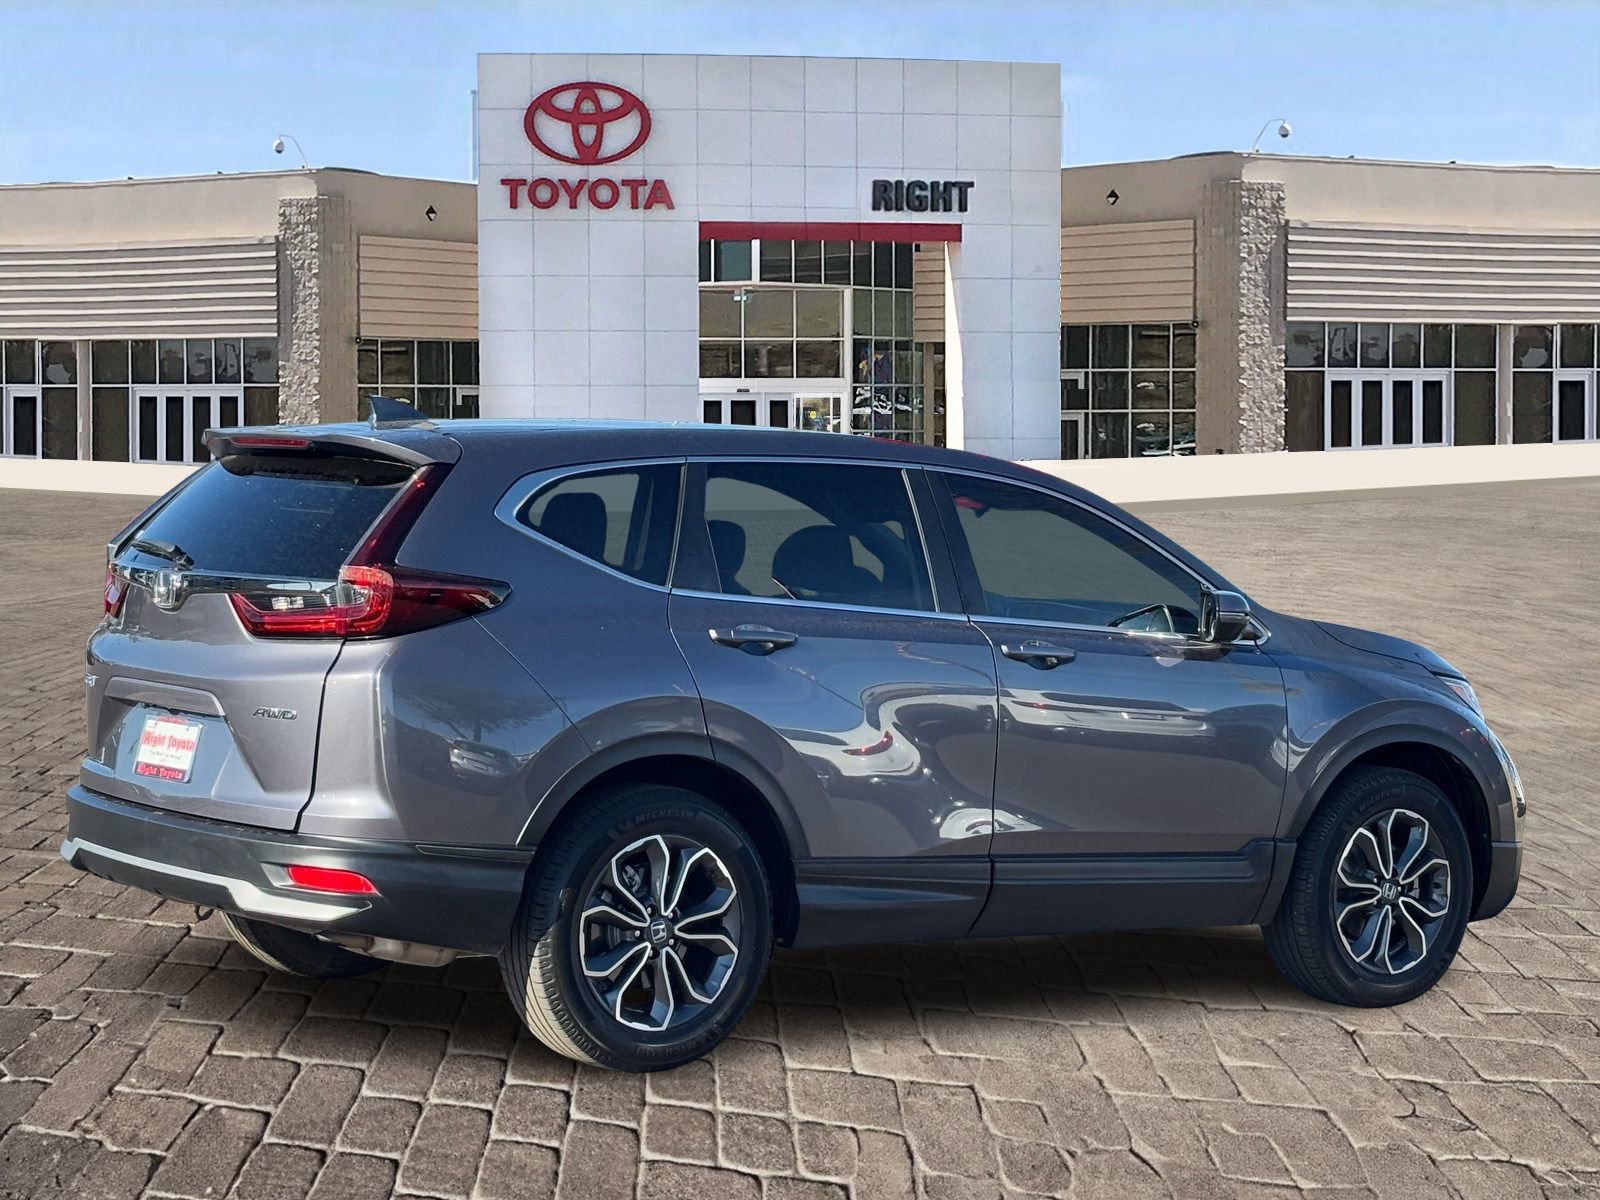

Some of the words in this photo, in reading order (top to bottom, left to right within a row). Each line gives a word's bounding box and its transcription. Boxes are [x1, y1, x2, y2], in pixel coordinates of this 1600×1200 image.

[500, 178, 675, 210] TOYOTA
[871, 179, 975, 212] RIGHT
[253, 706, 298, 721] AWD
[168, 735, 196, 752] Toyota
